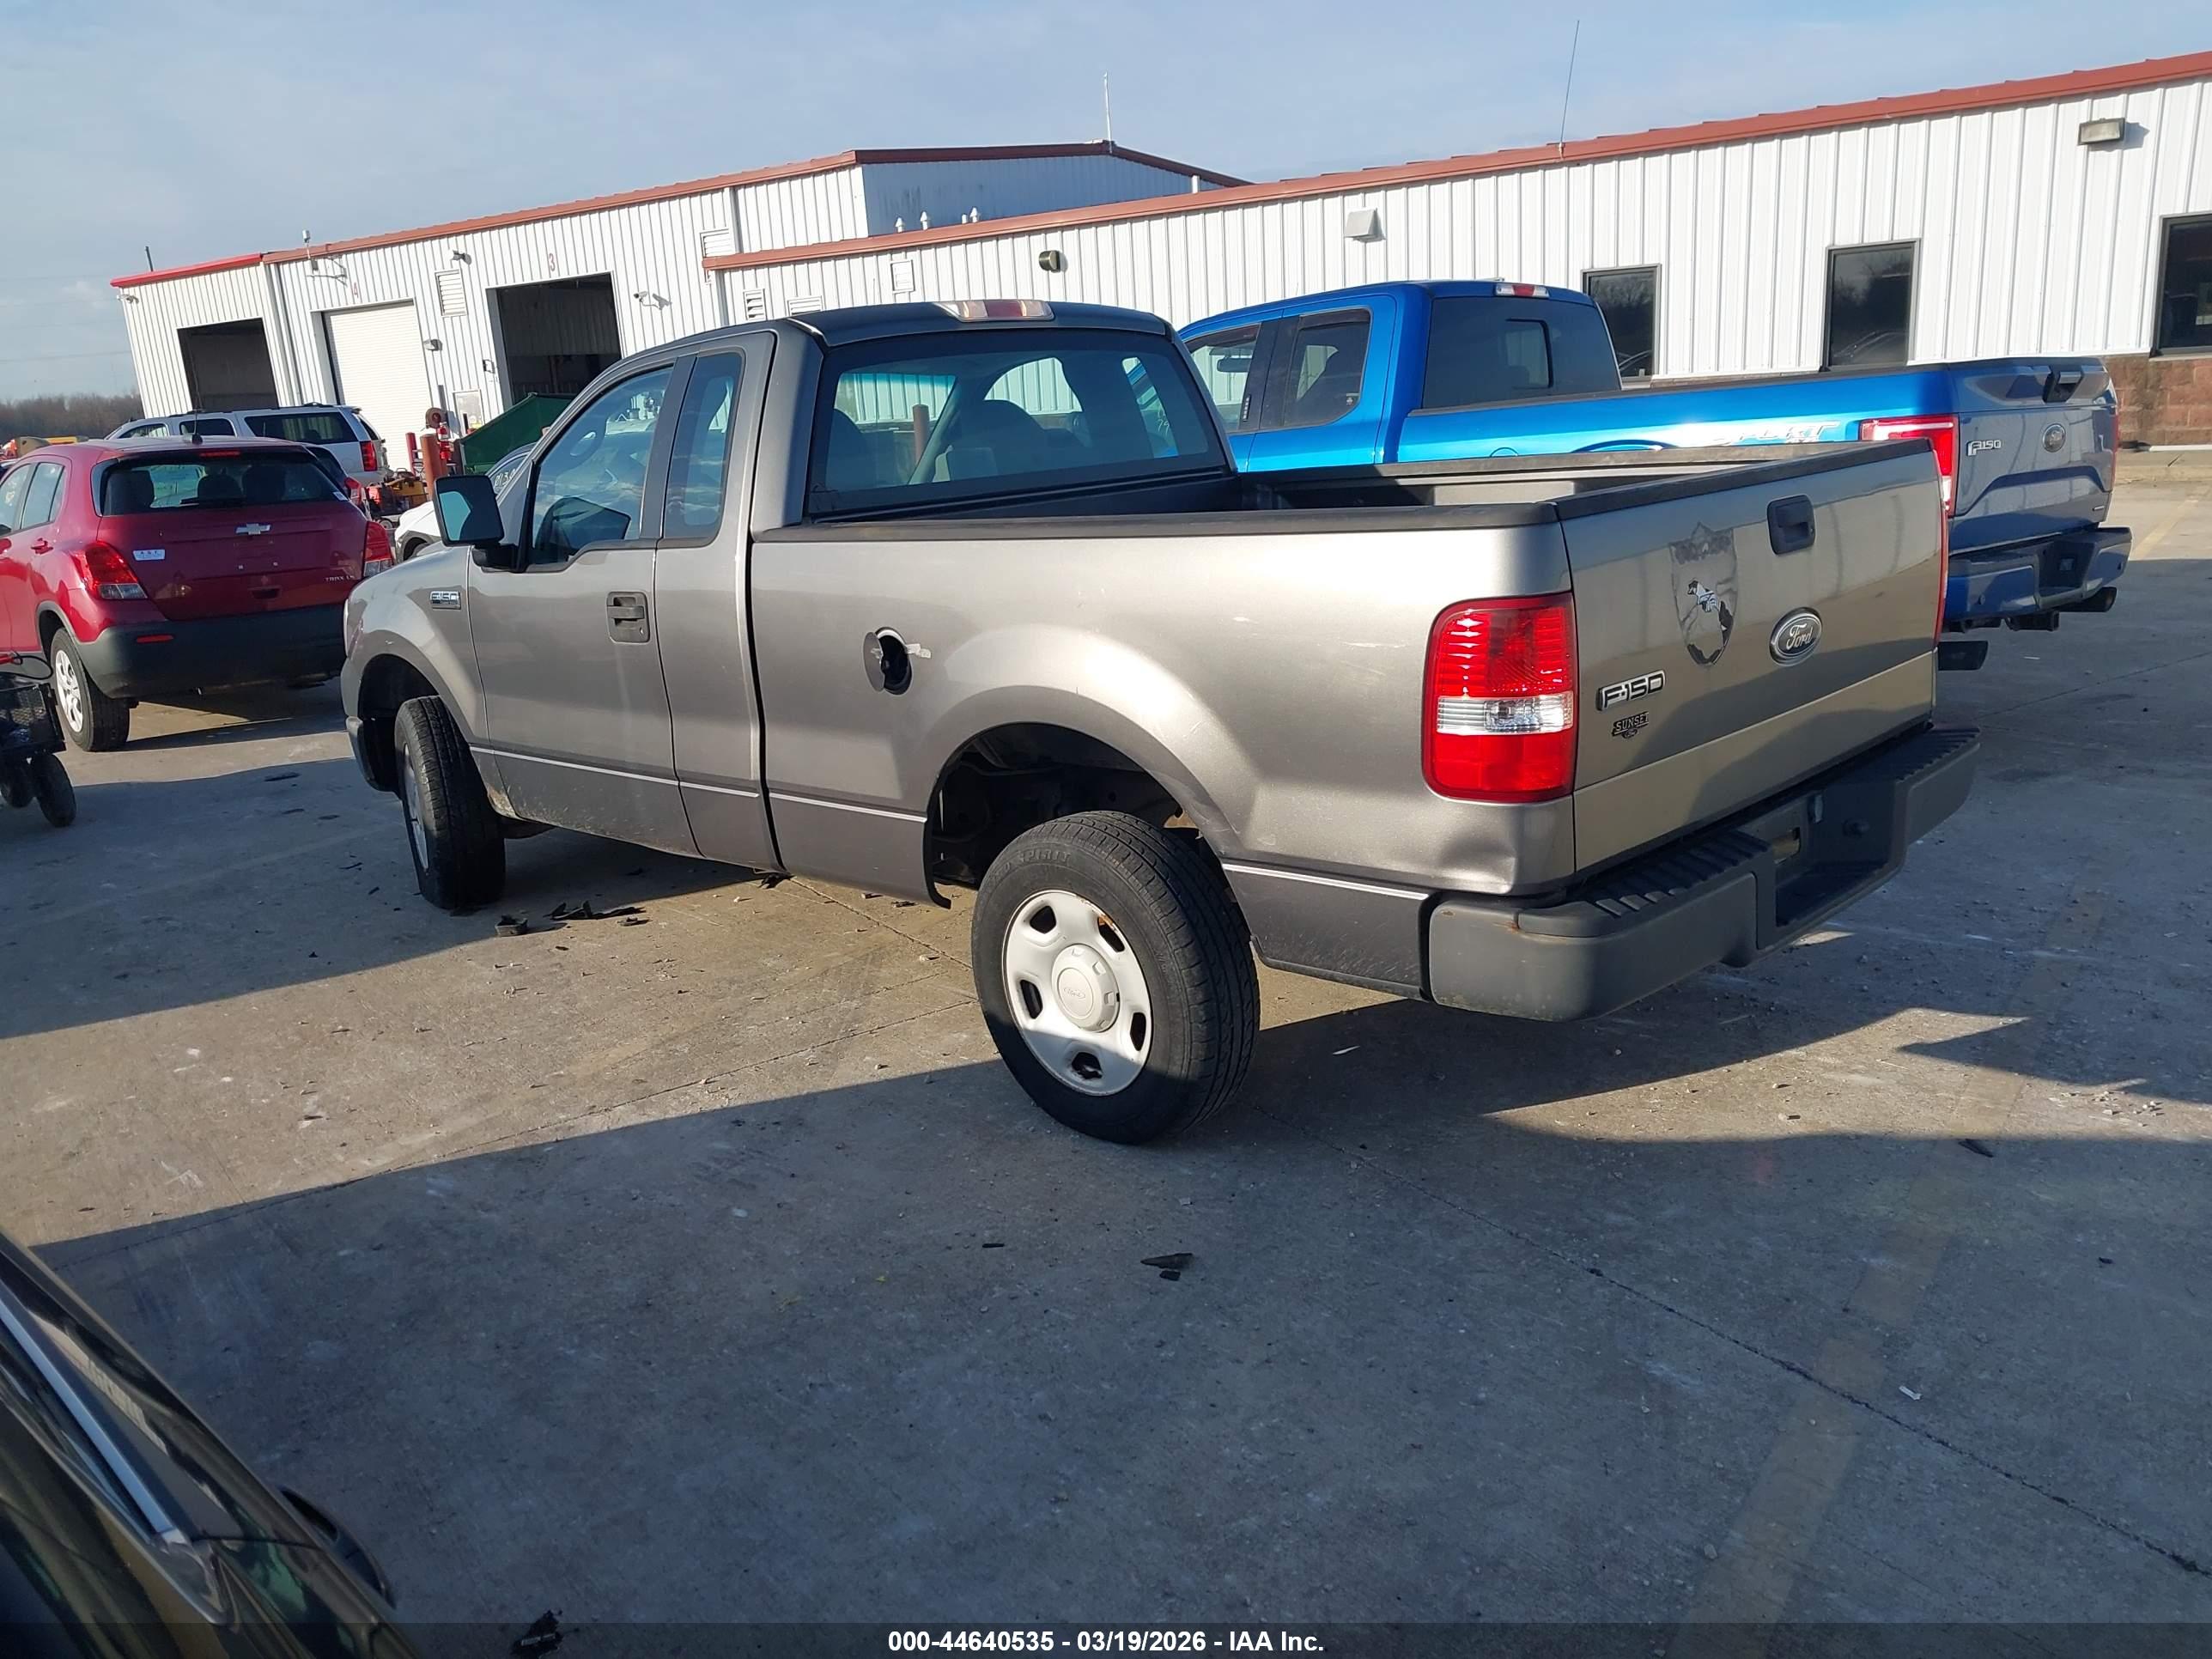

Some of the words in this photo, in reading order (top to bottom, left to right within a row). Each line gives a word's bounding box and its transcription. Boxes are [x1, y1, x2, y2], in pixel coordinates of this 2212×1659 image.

[549, 252, 556, 272] 3
[1601, 672, 1665, 709] F-150
[1615, 712, 1650, 732] SUNSET
